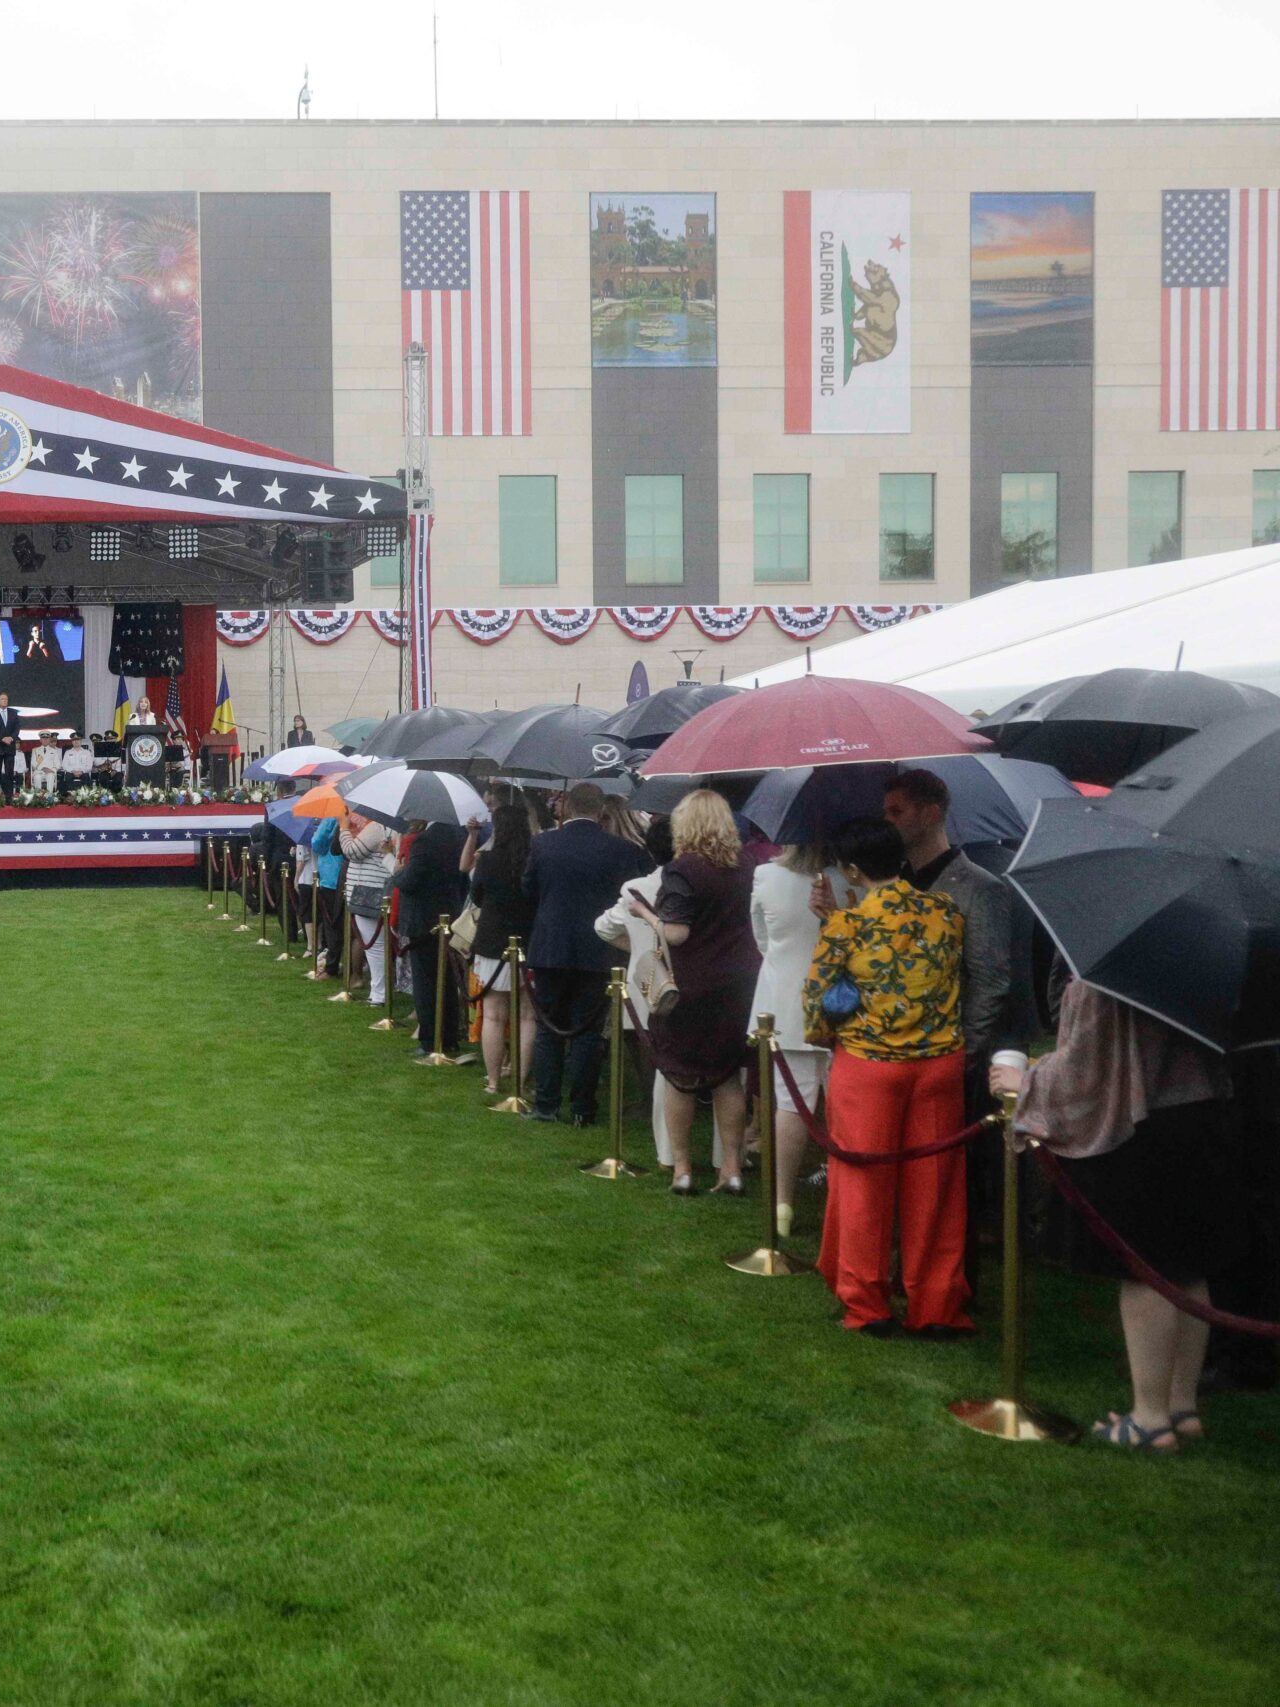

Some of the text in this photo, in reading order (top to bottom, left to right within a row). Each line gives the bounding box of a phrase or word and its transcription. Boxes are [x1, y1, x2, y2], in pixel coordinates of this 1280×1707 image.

[820, 231, 835, 397] CALIFORNIA REPUBLIC
[9, 417, 29, 449] AMERICA
[800, 746, 838, 754] CROWNE
[840, 743, 870, 751] PLAZA
